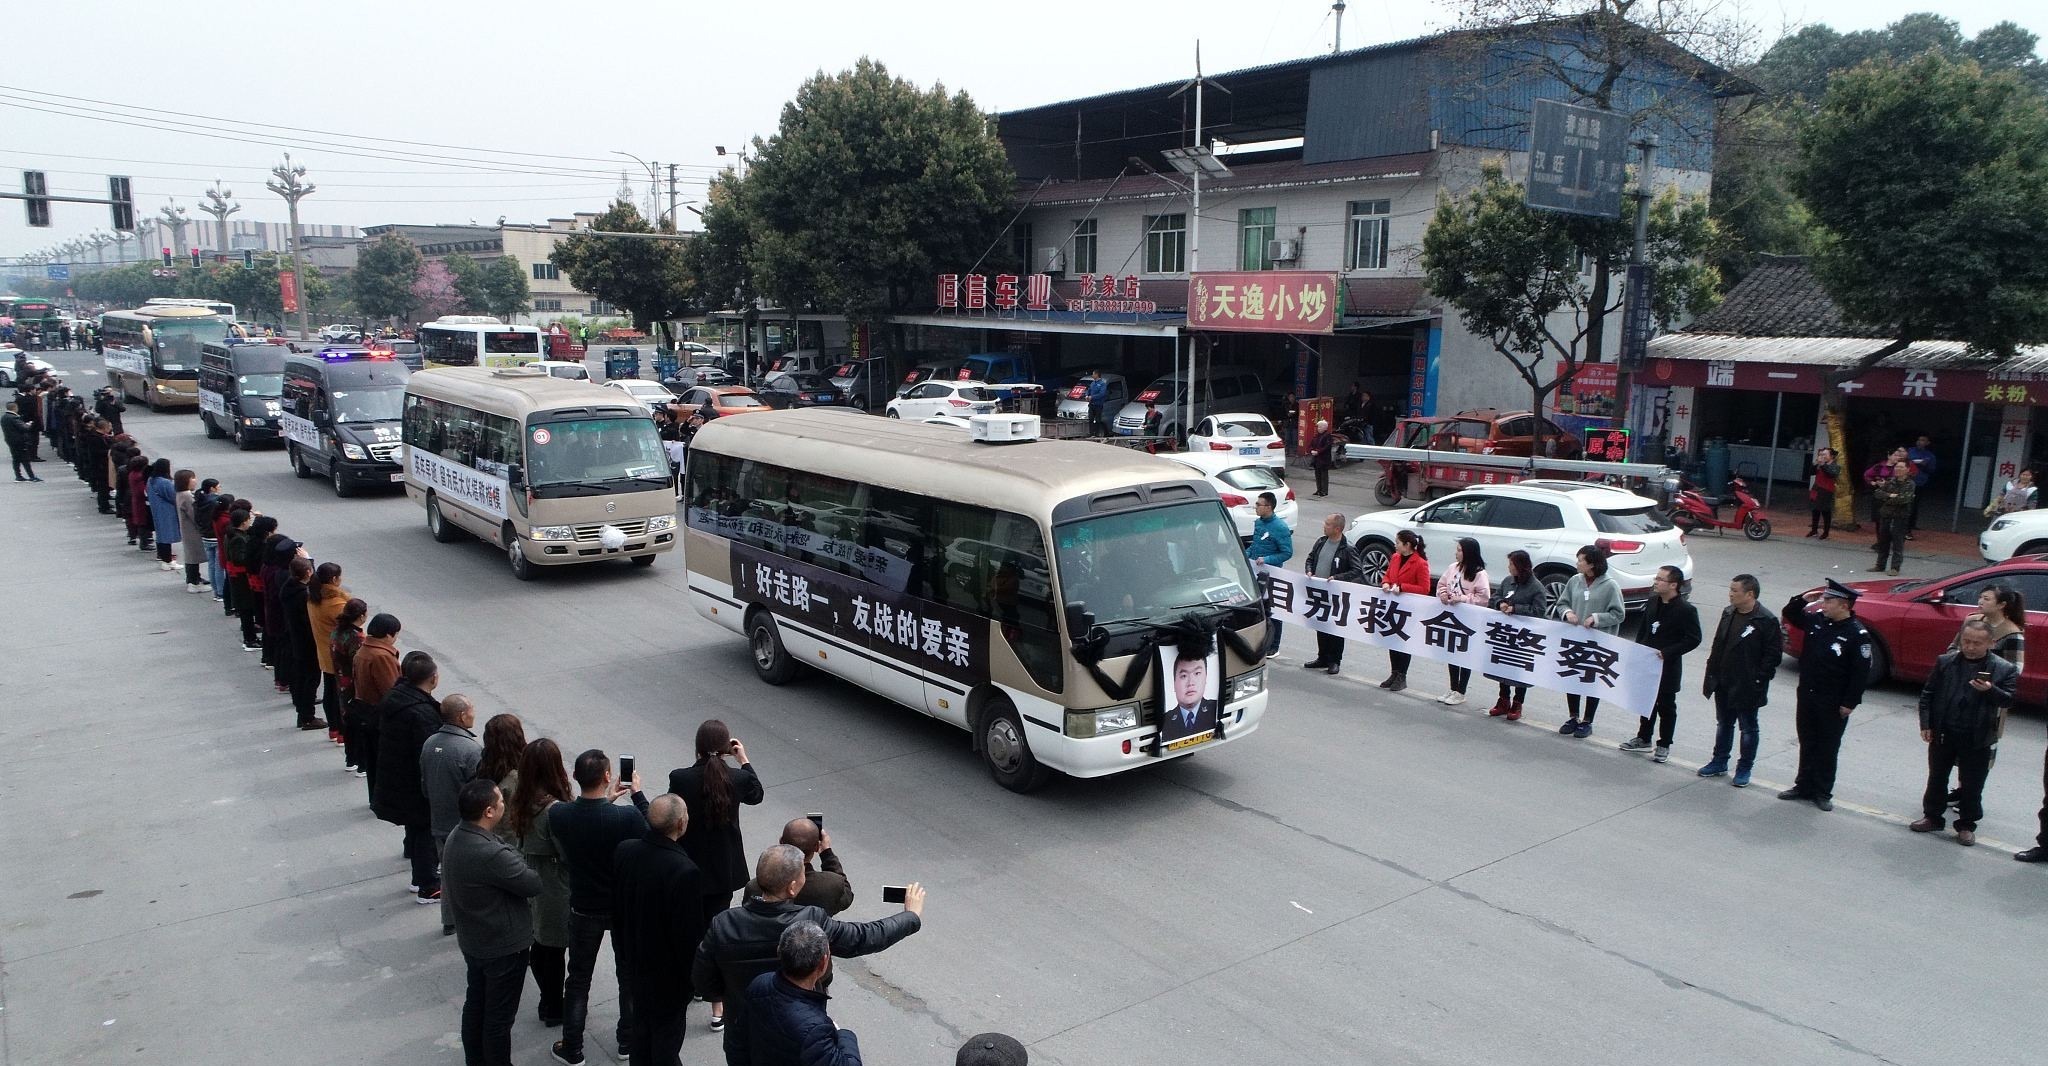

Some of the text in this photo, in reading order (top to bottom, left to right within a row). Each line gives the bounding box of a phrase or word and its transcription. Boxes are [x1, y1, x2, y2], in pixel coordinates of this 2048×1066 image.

[937, 273, 1054, 311] 恒信车业
[1079, 273, 1141, 299] 形象店
[1211, 283, 1328, 323] 天逸小炒
[1998, 425, 2022, 478] 牛肉
